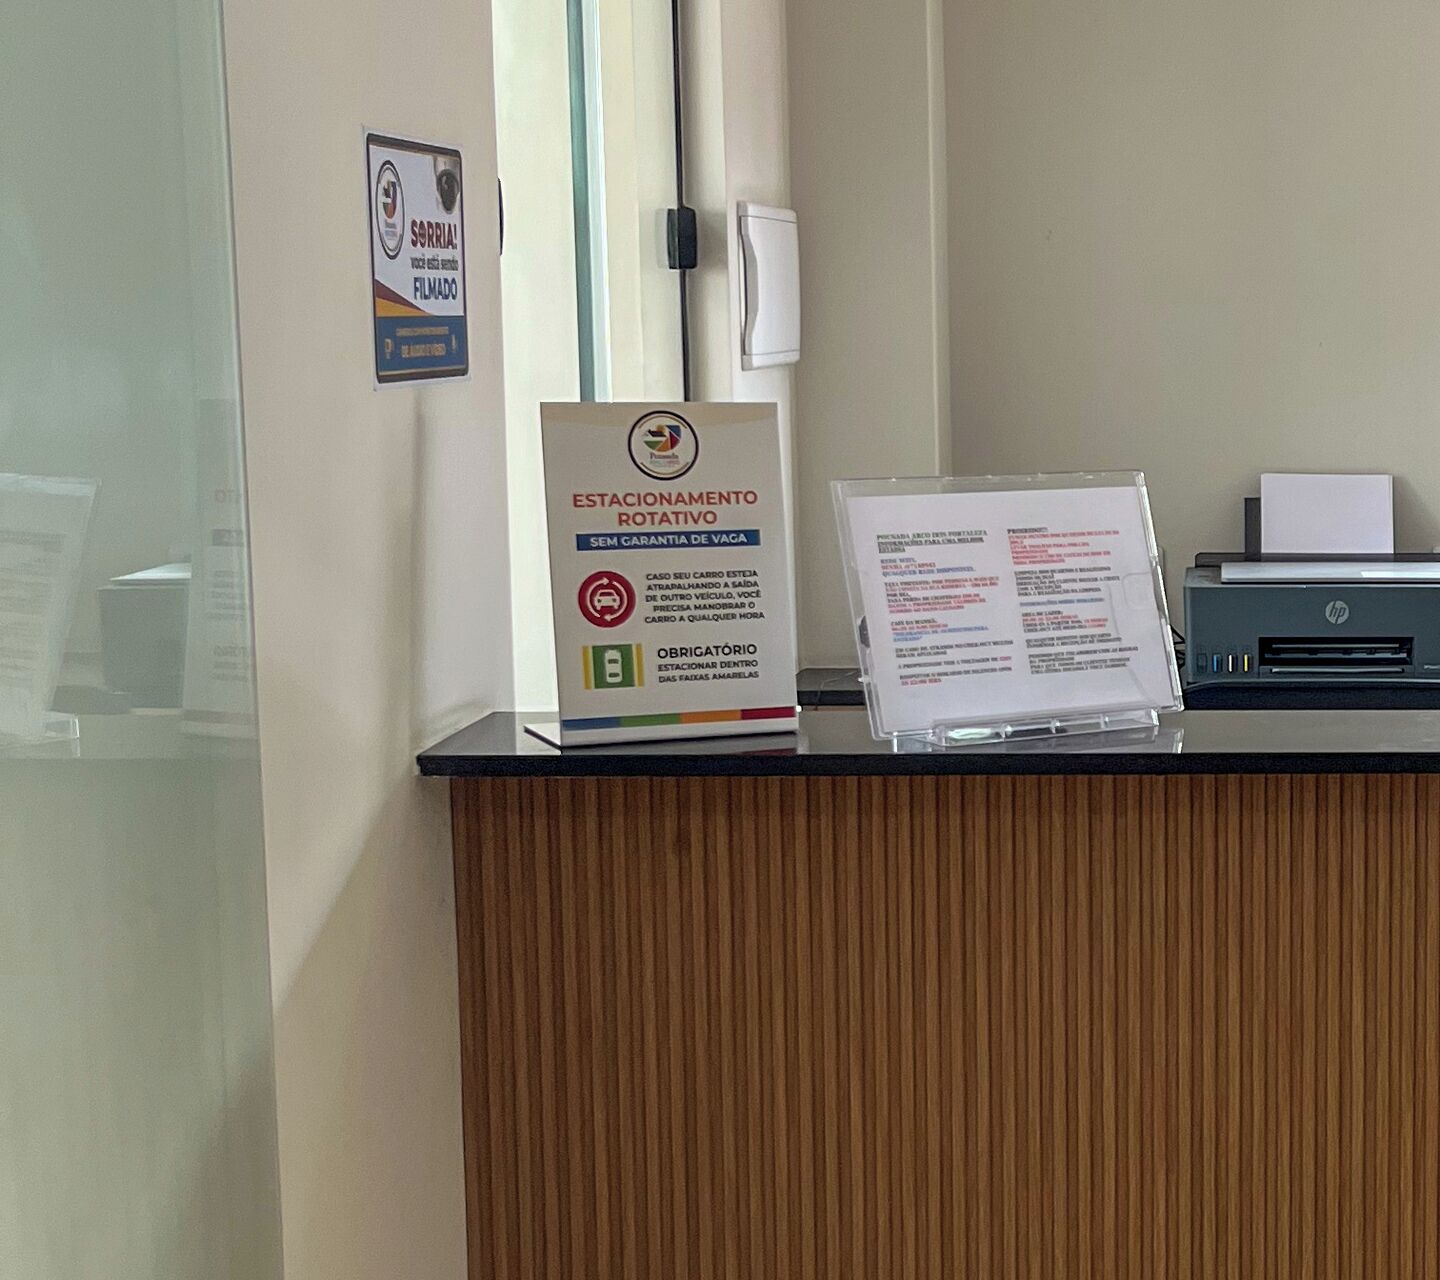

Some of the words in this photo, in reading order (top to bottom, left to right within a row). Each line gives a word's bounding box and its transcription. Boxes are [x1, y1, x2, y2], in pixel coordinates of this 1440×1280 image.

[411, 219, 457, 250] SORRIA!
[414, 277, 457, 300] FILMADO
[573, 490, 758, 508] ESTACIONAMENTO
[618, 510, 717, 526] ROTATIVO
[590, 534, 617, 547] SEM
[622, 533, 687, 546] GARANTIA
[690, 534, 708, 544] DE
[712, 532, 747, 543] VAGA
[693, 571, 724, 579] CARRO
[726, 570, 758, 578] ESTEJA
[646, 582, 721, 591] ATRAPALHANDO
[732, 579, 759, 588] SAÍDA
[694, 591, 735, 600] VEÍCULO,
[737, 590, 761, 598] VOCÊ
[694, 602, 746, 610] MANOBRAR
[1327, 600, 1348, 624] hp
[688, 613, 736, 622] QUALQUER
[657, 642, 757, 658] OBRIGATÓRIO
[658, 662, 717, 671] ESTACIONAR
[720, 660, 758, 668] DENTRO
[679, 673, 710, 682] FAIXAS
[712, 671, 759, 680] AMARELAS
